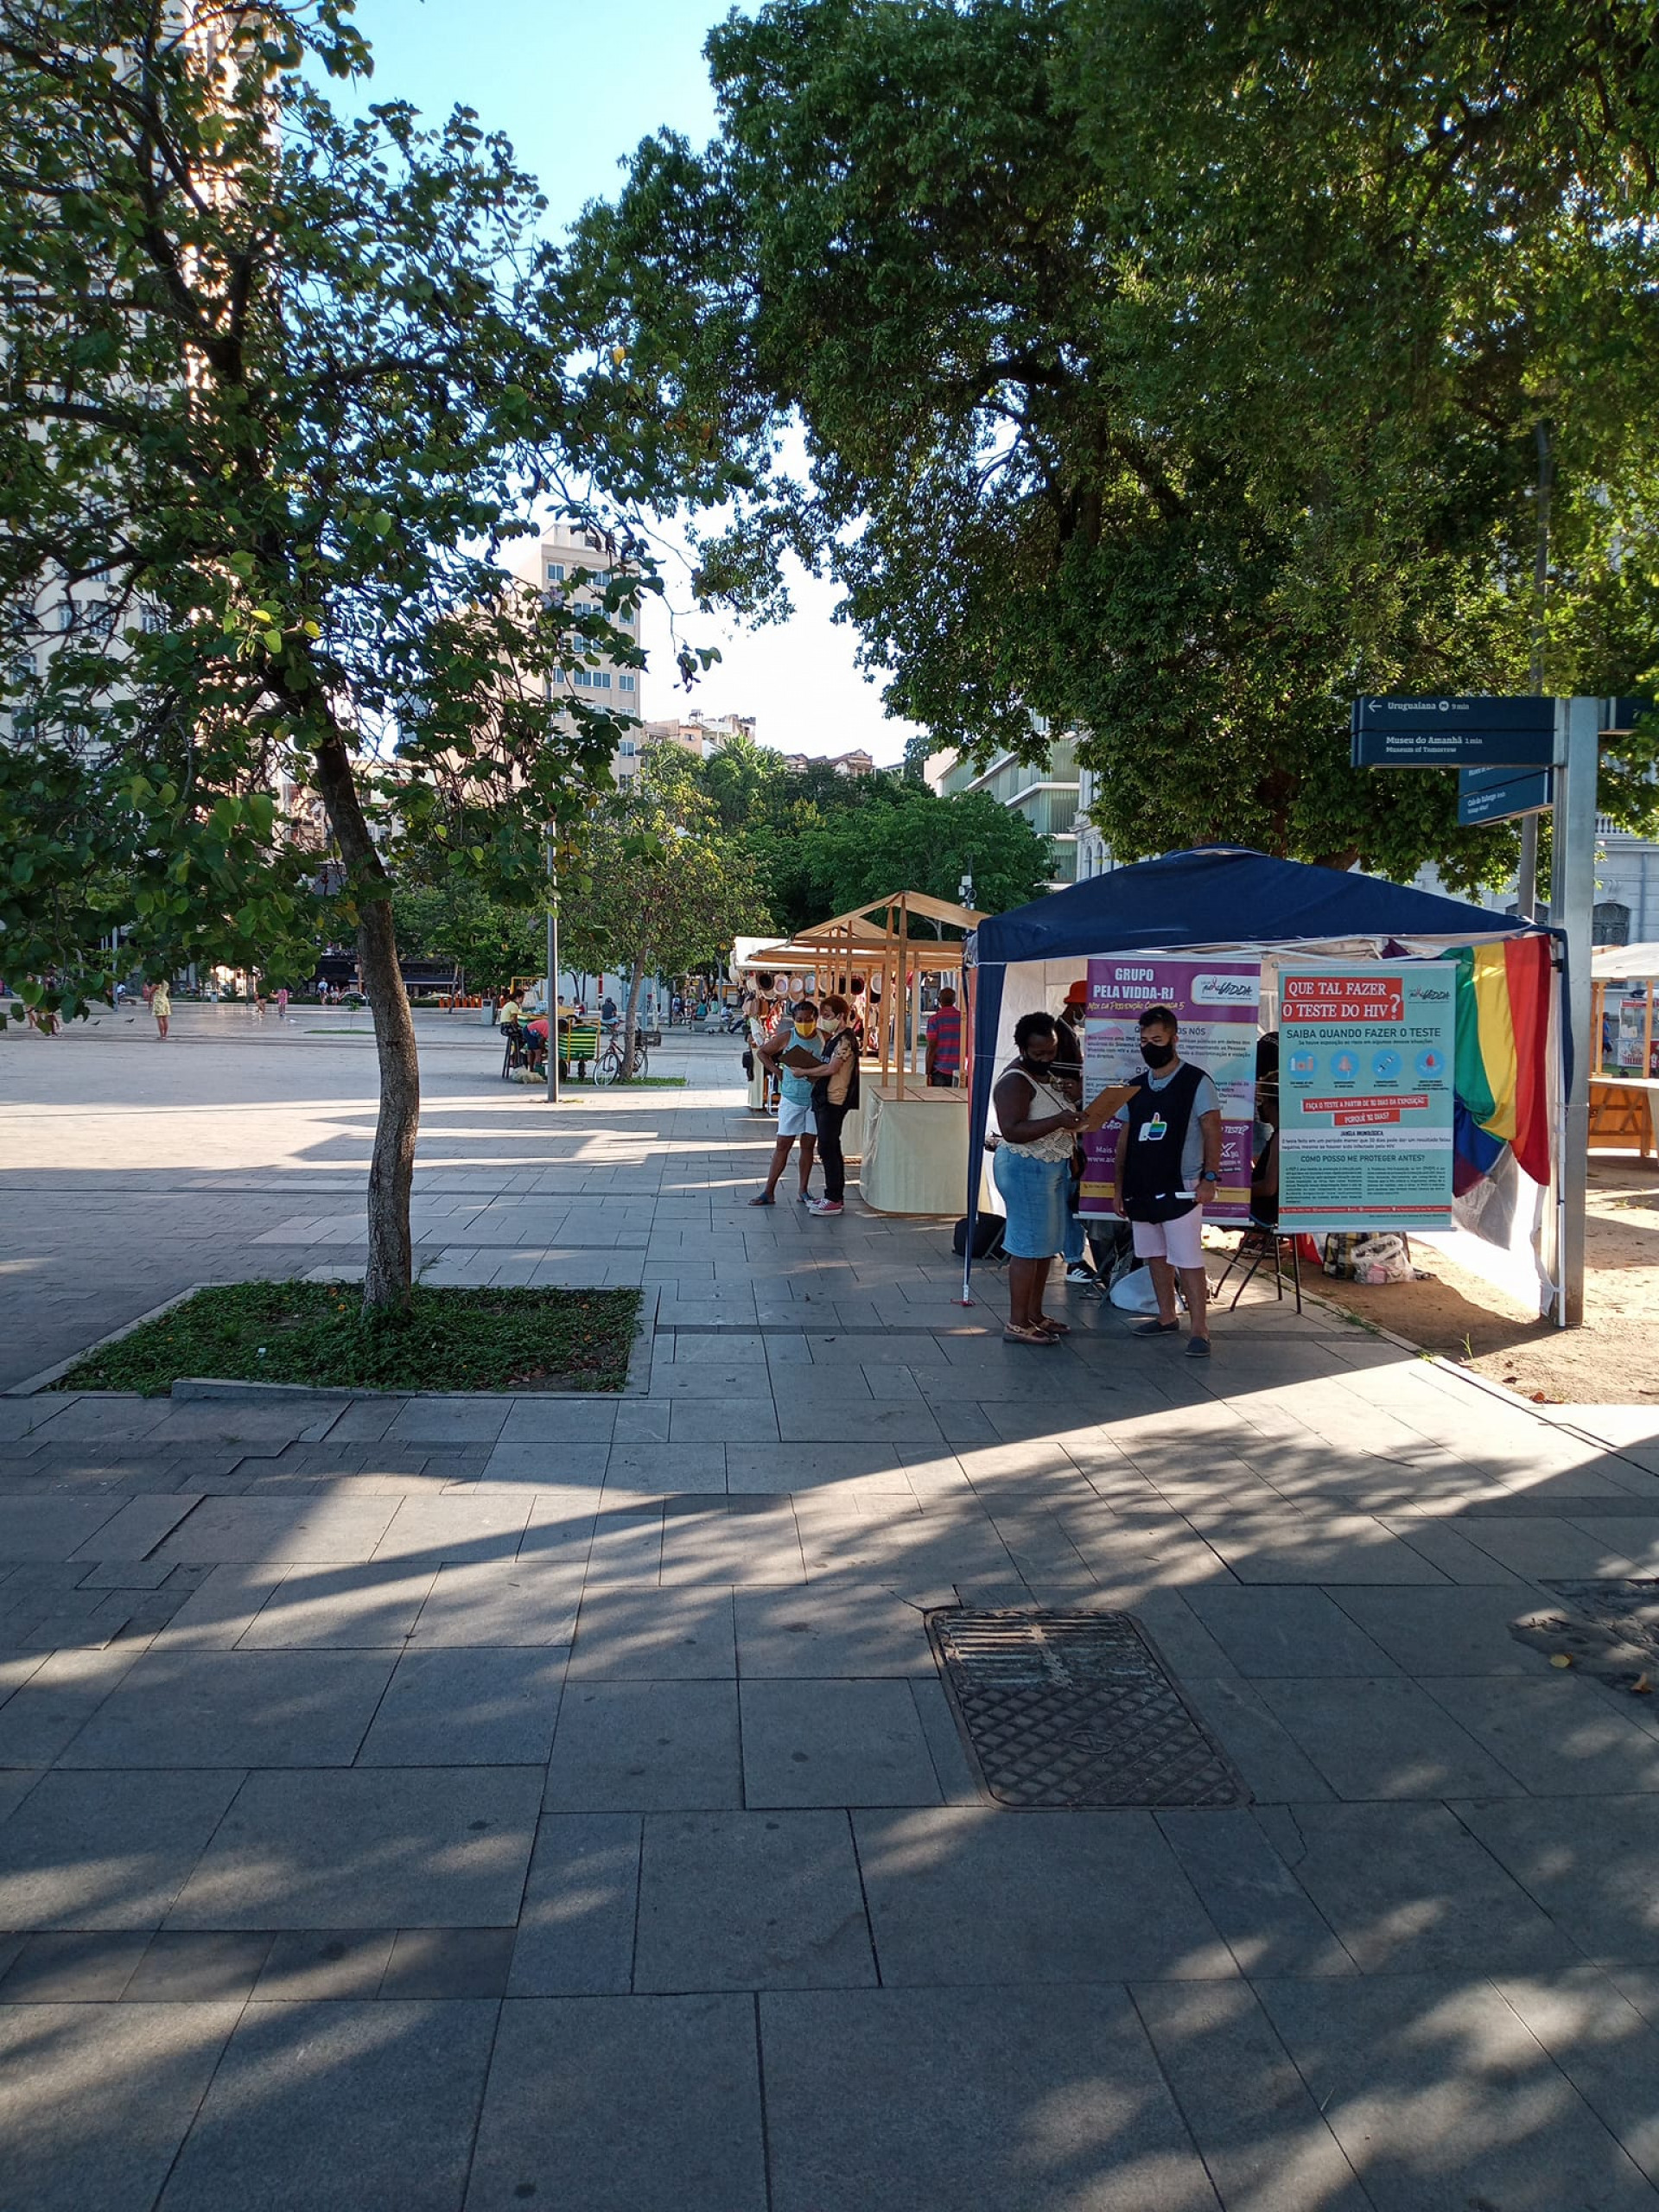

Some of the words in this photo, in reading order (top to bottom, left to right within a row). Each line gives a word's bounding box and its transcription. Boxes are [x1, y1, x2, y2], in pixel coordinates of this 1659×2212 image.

[1388, 702, 1436, 711] Uruguaiana
[1428, 735, 1463, 744] Amanhã
[1115, 968, 1154, 982] GRUPO
[1093, 985, 1120, 998] PELA
[1122, 986, 1174, 1000] VIDDA-RJ
[1288, 982, 1314, 996] QUE
[1318, 982, 1342, 995] TAL
[1345, 982, 1387, 995] FAZER
[1282, 1004, 1293, 1017] O
[1296, 1004, 1337, 1017] TESTE
[1341, 1004, 1360, 1017] DO
[1189, 1027, 1206, 1035] NÓS
[1287, 1029, 1316, 1039] SAIBA
[1319, 1029, 1362, 1038] QUANDO
[1365, 1028, 1396, 1037] FAZER
[1400, 1028, 1407, 1037] O
[1409, 1027, 1440, 1037] TESTE
[1398, 1154, 1426, 1162] ANTES?
